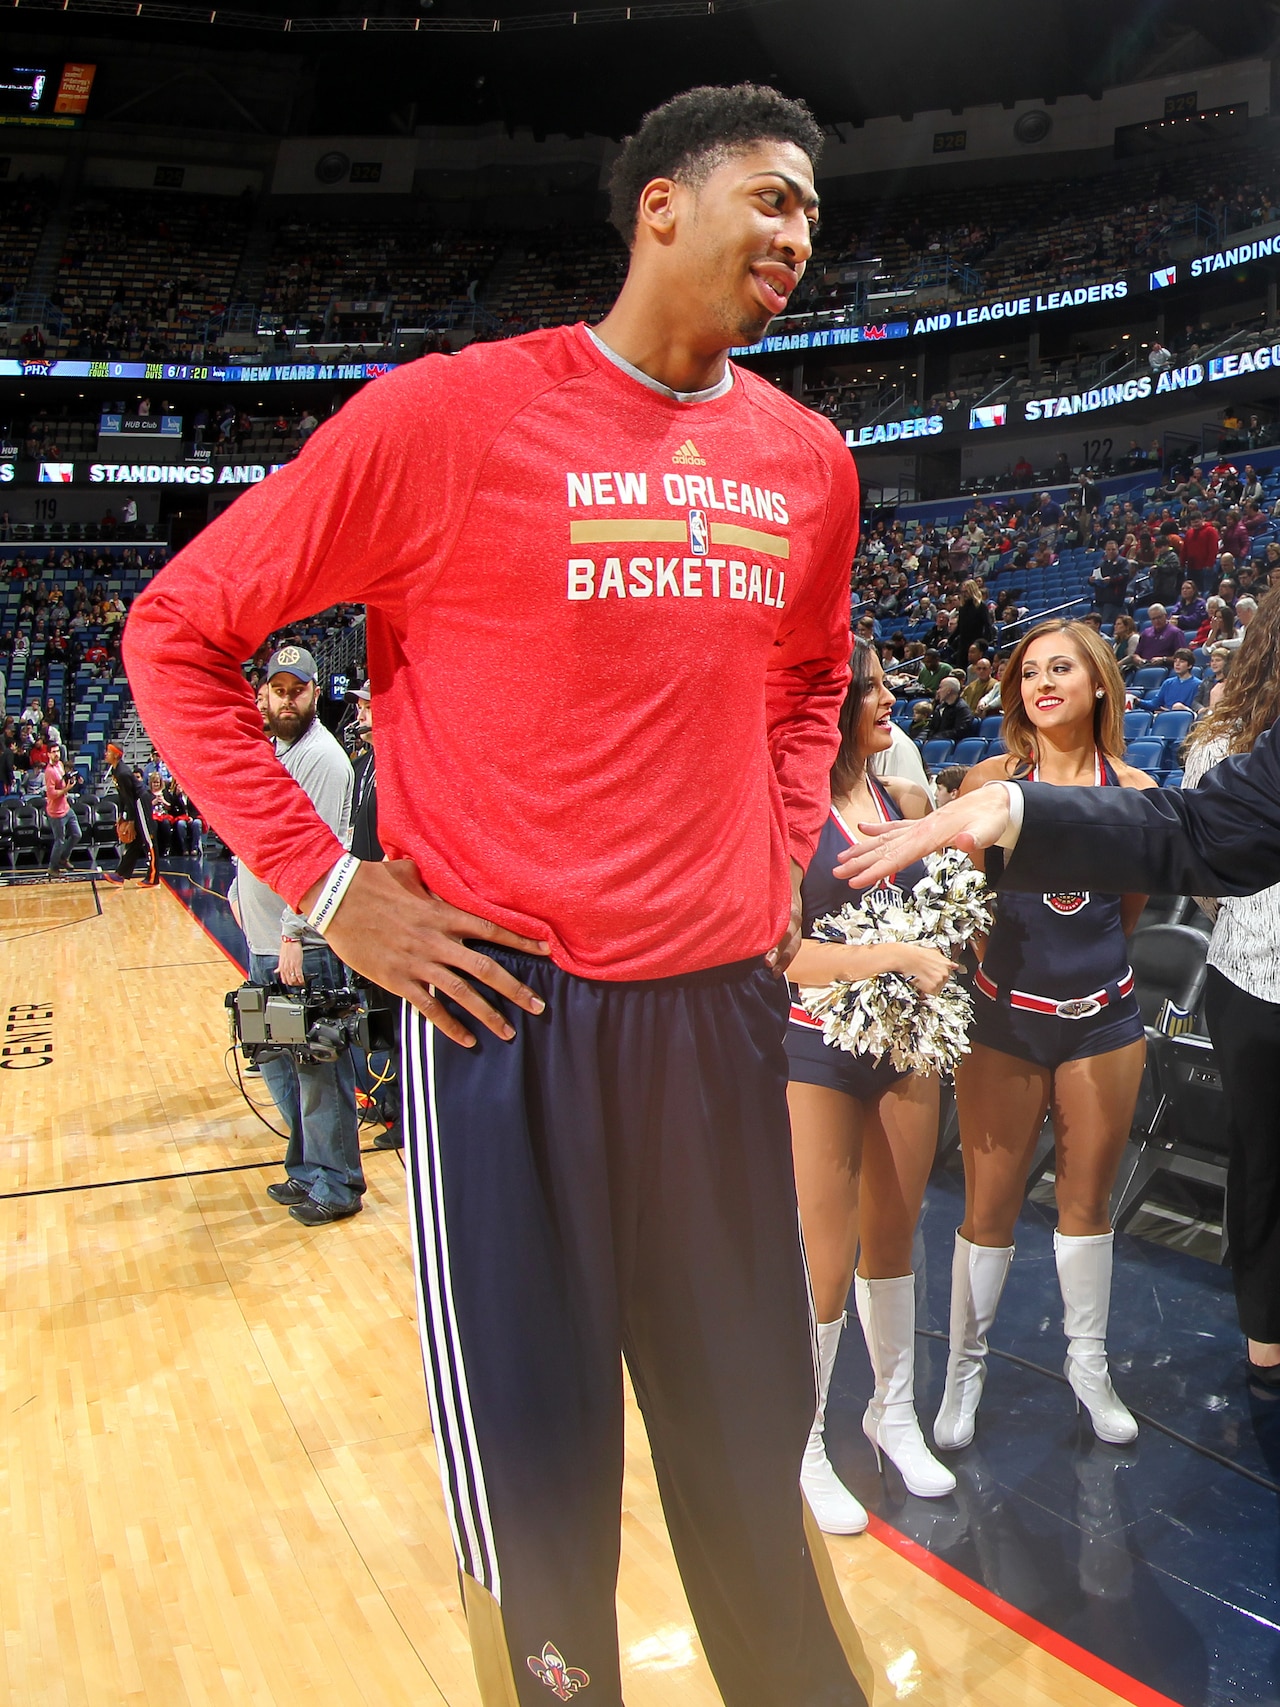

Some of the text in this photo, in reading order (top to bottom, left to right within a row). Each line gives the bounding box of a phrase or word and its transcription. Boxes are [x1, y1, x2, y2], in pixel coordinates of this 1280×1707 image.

[914, 281, 1128, 334] AND LEAGUE LEADERS
[767, 333, 808, 352] YEARS
[812, 331, 830, 347] AT
[833, 328, 859, 344] THE
[24, 365, 48, 376] PHX
[91, 362, 109, 370] TEAM
[115, 364, 122, 376] 0
[145, 371, 163, 379] OUTS
[241, 365, 362, 381] NEW YEARS AT THE
[1024, 375, 1152, 421] STANDINGS
[1156, 364, 1204, 395] AND
[846, 415, 943, 448] LEADERS
[672, 455, 706, 466] adidas
[1082, 438, 1113, 462] 122
[90, 464, 214, 484] STANDINGS
[217, 465, 266, 484] AND
[35, 499, 57, 520] 119
[567, 472, 789, 525] NEW ORLEANS
[567, 557, 785, 609] BASKETBALL
[0, 1002, 54, 1069] CENTER
